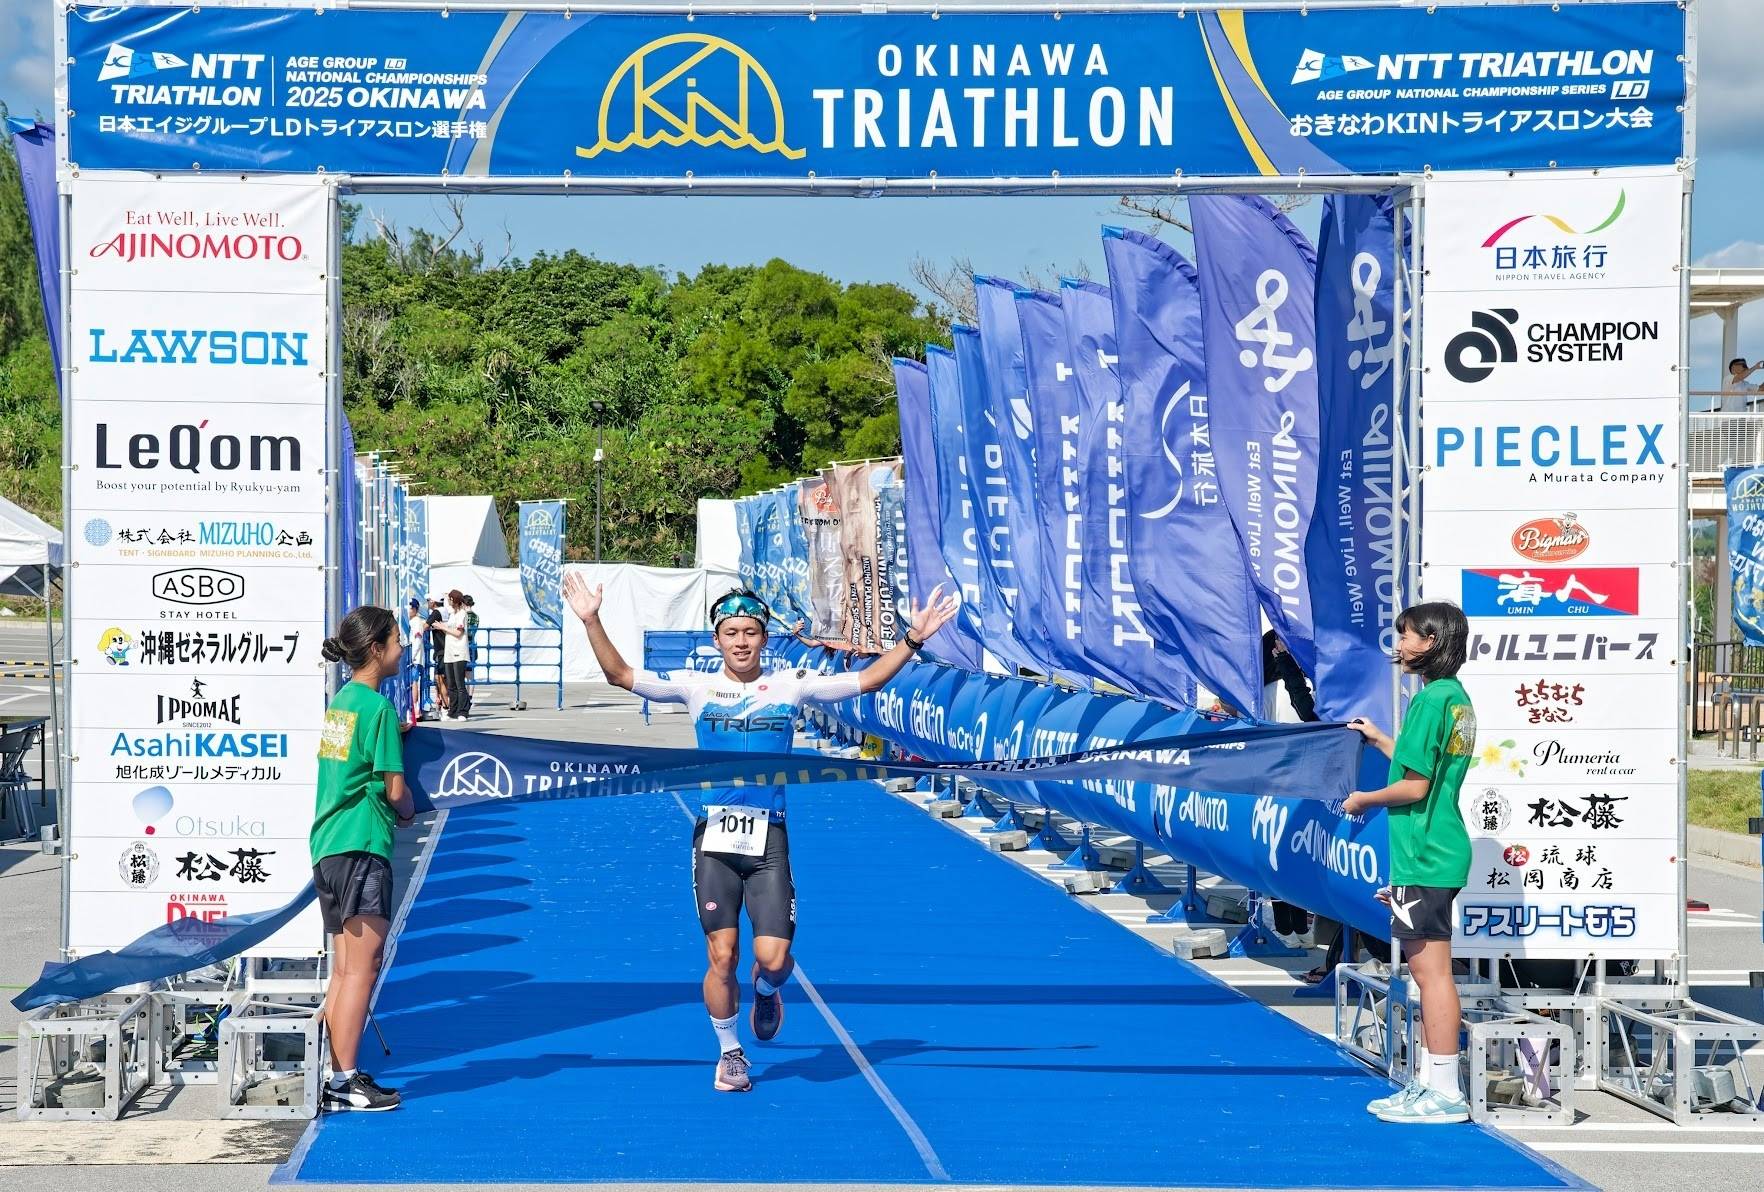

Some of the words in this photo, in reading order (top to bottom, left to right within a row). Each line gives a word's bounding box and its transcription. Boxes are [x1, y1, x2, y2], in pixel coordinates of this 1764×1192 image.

[191, 54, 265, 79] NTT
[286, 57, 318, 69] AGE
[322, 57, 377, 69] GROUP
[385, 58, 407, 70] LD
[878, 44, 1109, 76] OKINAWA
[1377, 52, 1456, 80] NTT
[1457, 50, 1654, 78] TRIATHLON
[286, 71, 362, 84] NATIONAL
[365, 72, 488, 85] CHAMPIONSHIPS
[110, 84, 261, 106] TRIATHLON
[286, 87, 343, 107] 2025
[347, 87, 487, 109] OKINAWA
[1317, 90, 1343, 100] AGE
[1346, 89, 1391, 100] GROUP
[1396, 88, 1459, 98] NATIONAL
[1463, 86, 1559, 98] CHAMPIONSHIP
[1562, 84, 1606, 95] SERIES
[1612, 81, 1649, 99] LD
[99, 116, 487, 139] 日本エイジグループLDトライアスロン選手権
[813, 87, 1173, 148] TRIATHLON
[1289, 106, 1654, 137] おきなわKINトライアスロン大会
[126, 210, 151, 225] Eat
[157, 211, 199, 227] Well,
[205, 212, 239, 226] Live
[243, 212, 285, 228] Well.
[89, 233, 302, 262] AJINOMOTO
[1495, 245, 1608, 270] 日本旅行
[1570, 272, 1606, 280] AGENCY
[1527, 321, 1658, 342] CHAMPION
[89, 329, 308, 366] LAWSON
[1527, 342, 1623, 363] SYSTEM
[1436, 424, 1665, 467] PIECLEX
[96, 480, 127, 490] Boost
[131, 482, 157, 492] your
[160, 480, 211, 493] potential
[215, 481, 228, 493] by
[230, 481, 301, 494] Ryukyu-yam
[1529, 473, 1537, 483] A
[1544, 472, 1593, 483] Murata
[1600, 471, 1665, 484] Company
[1519, 527, 1584, 553] Bigman
[119, 549, 139, 557] TENT
[147, 550, 196, 558] SIGNBOARD
[200, 550, 235, 558] MIZUHO
[236, 550, 281, 559] PLANNING
[162, 574, 235, 598] ASBO
[160, 611, 190, 619] STAY
[197, 611, 238, 619] HOTEL
[1507, 605, 1534, 614] UMIN
[1567, 605, 1590, 614] CHU
[140, 630, 300, 665] 沖縄ゼネラルグループ
[1468, 633, 1659, 661] トルユニバース
[157, 694, 240, 725] IPPOMAE
[1528, 707, 1574, 724] きなこ
[703, 716, 788, 733] TRISE
[1533, 739, 1621, 766] Plumeria
[116, 765, 281, 781] 旭化成ゾールメディカル
[550, 761, 641, 775] OKINAWA
[1586, 766, 1607, 775] rent
[1618, 767, 1636, 775] car
[1528, 793, 1629, 829] 松藤
[175, 816, 265, 837] Otsuka
[720, 815, 755, 835] 1011
[176, 848, 276, 883] 松藤
[1540, 846, 1597, 866] 琉球
[1486, 867, 1614, 890] 松岡商店
[170, 894, 225, 902] OKINAWA
[1464, 905, 1636, 937] アスリートもち
